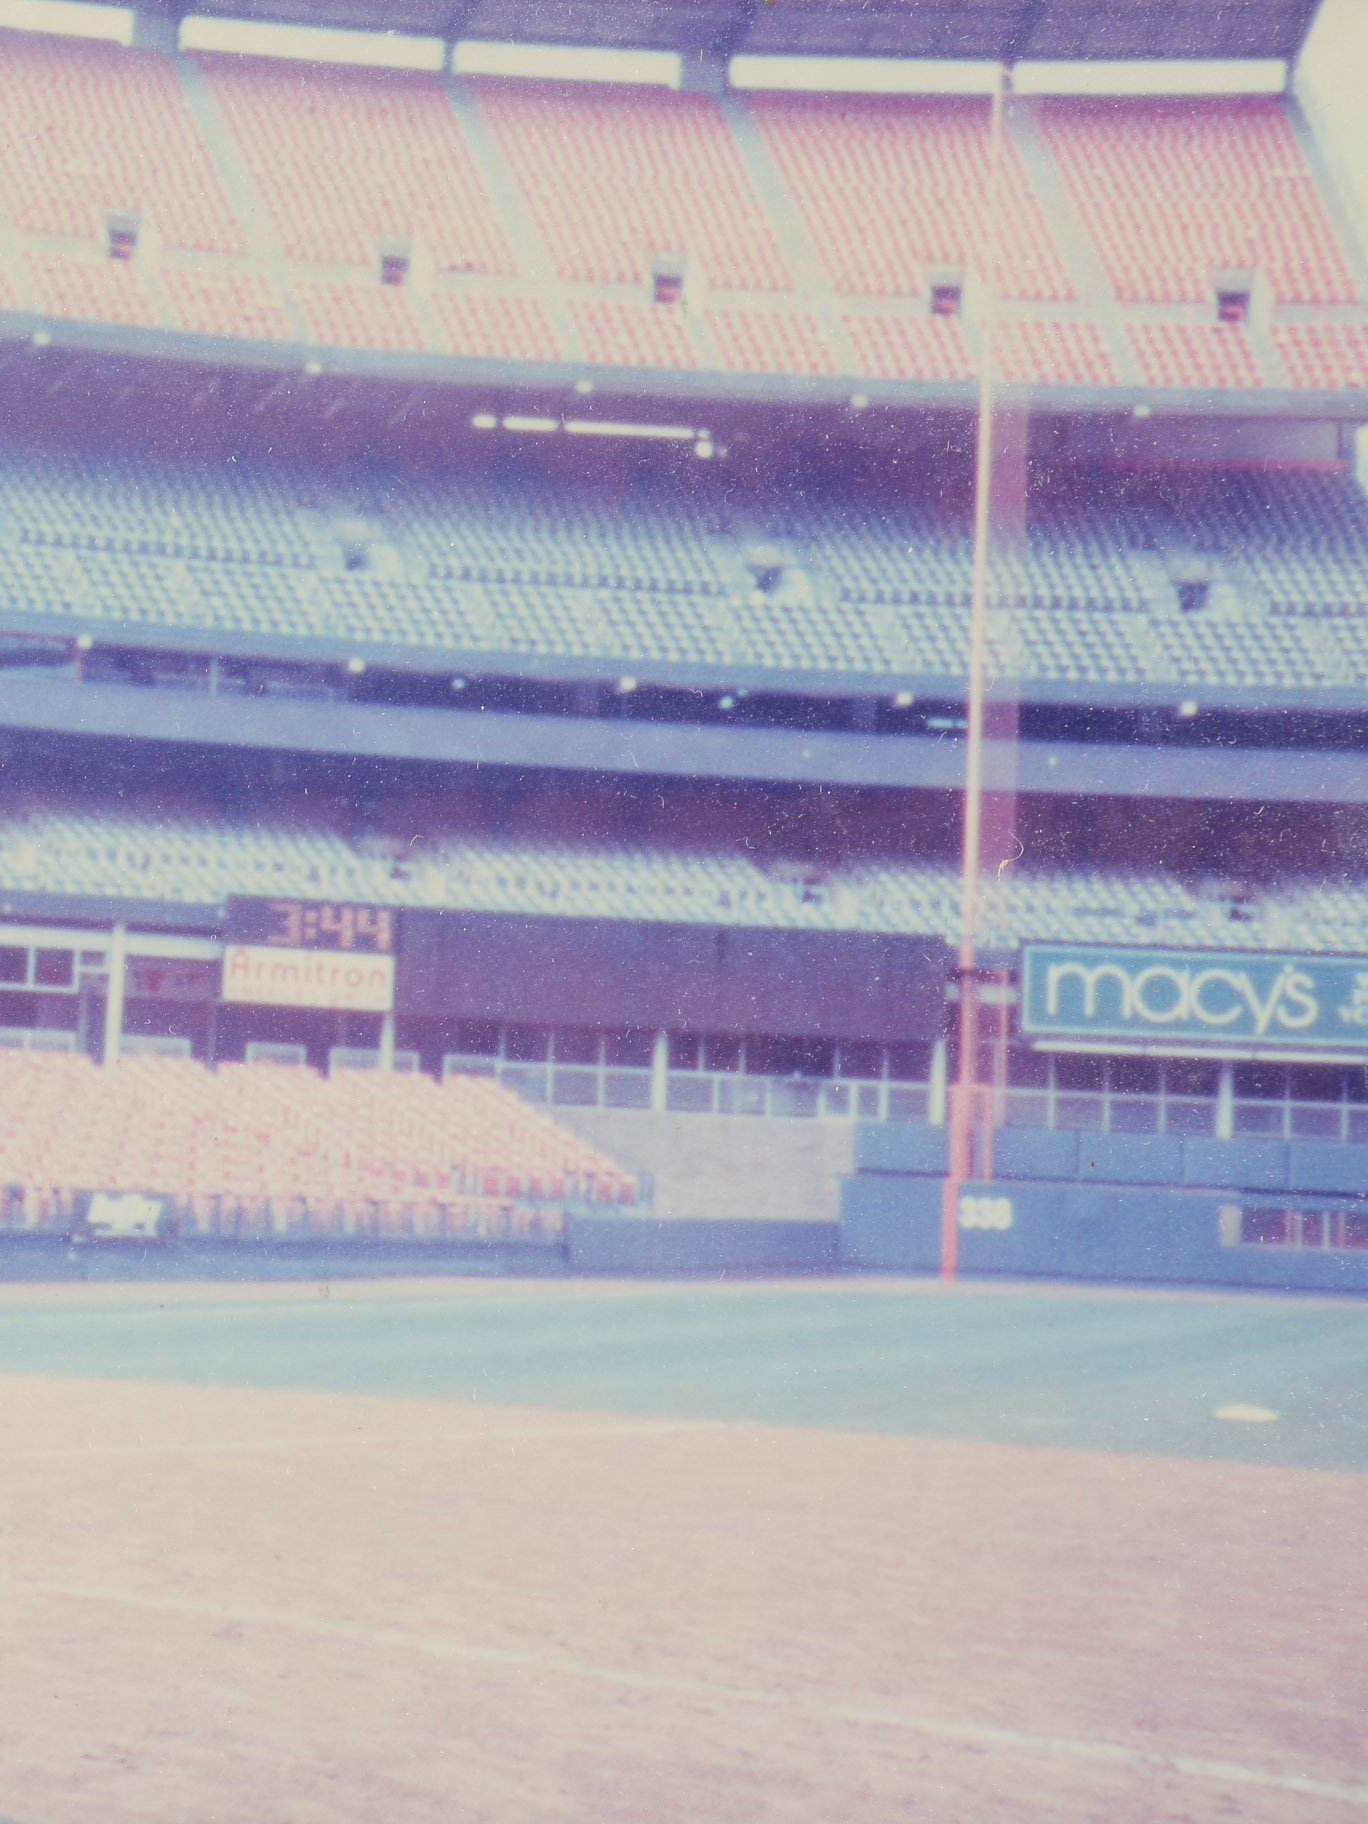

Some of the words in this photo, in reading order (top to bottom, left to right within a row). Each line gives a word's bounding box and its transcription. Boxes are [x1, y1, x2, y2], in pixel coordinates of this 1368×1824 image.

[268, 902, 391, 951] 3:44
[231, 947, 387, 988] Armitron
[1046, 962, 1319, 1035] macy's
